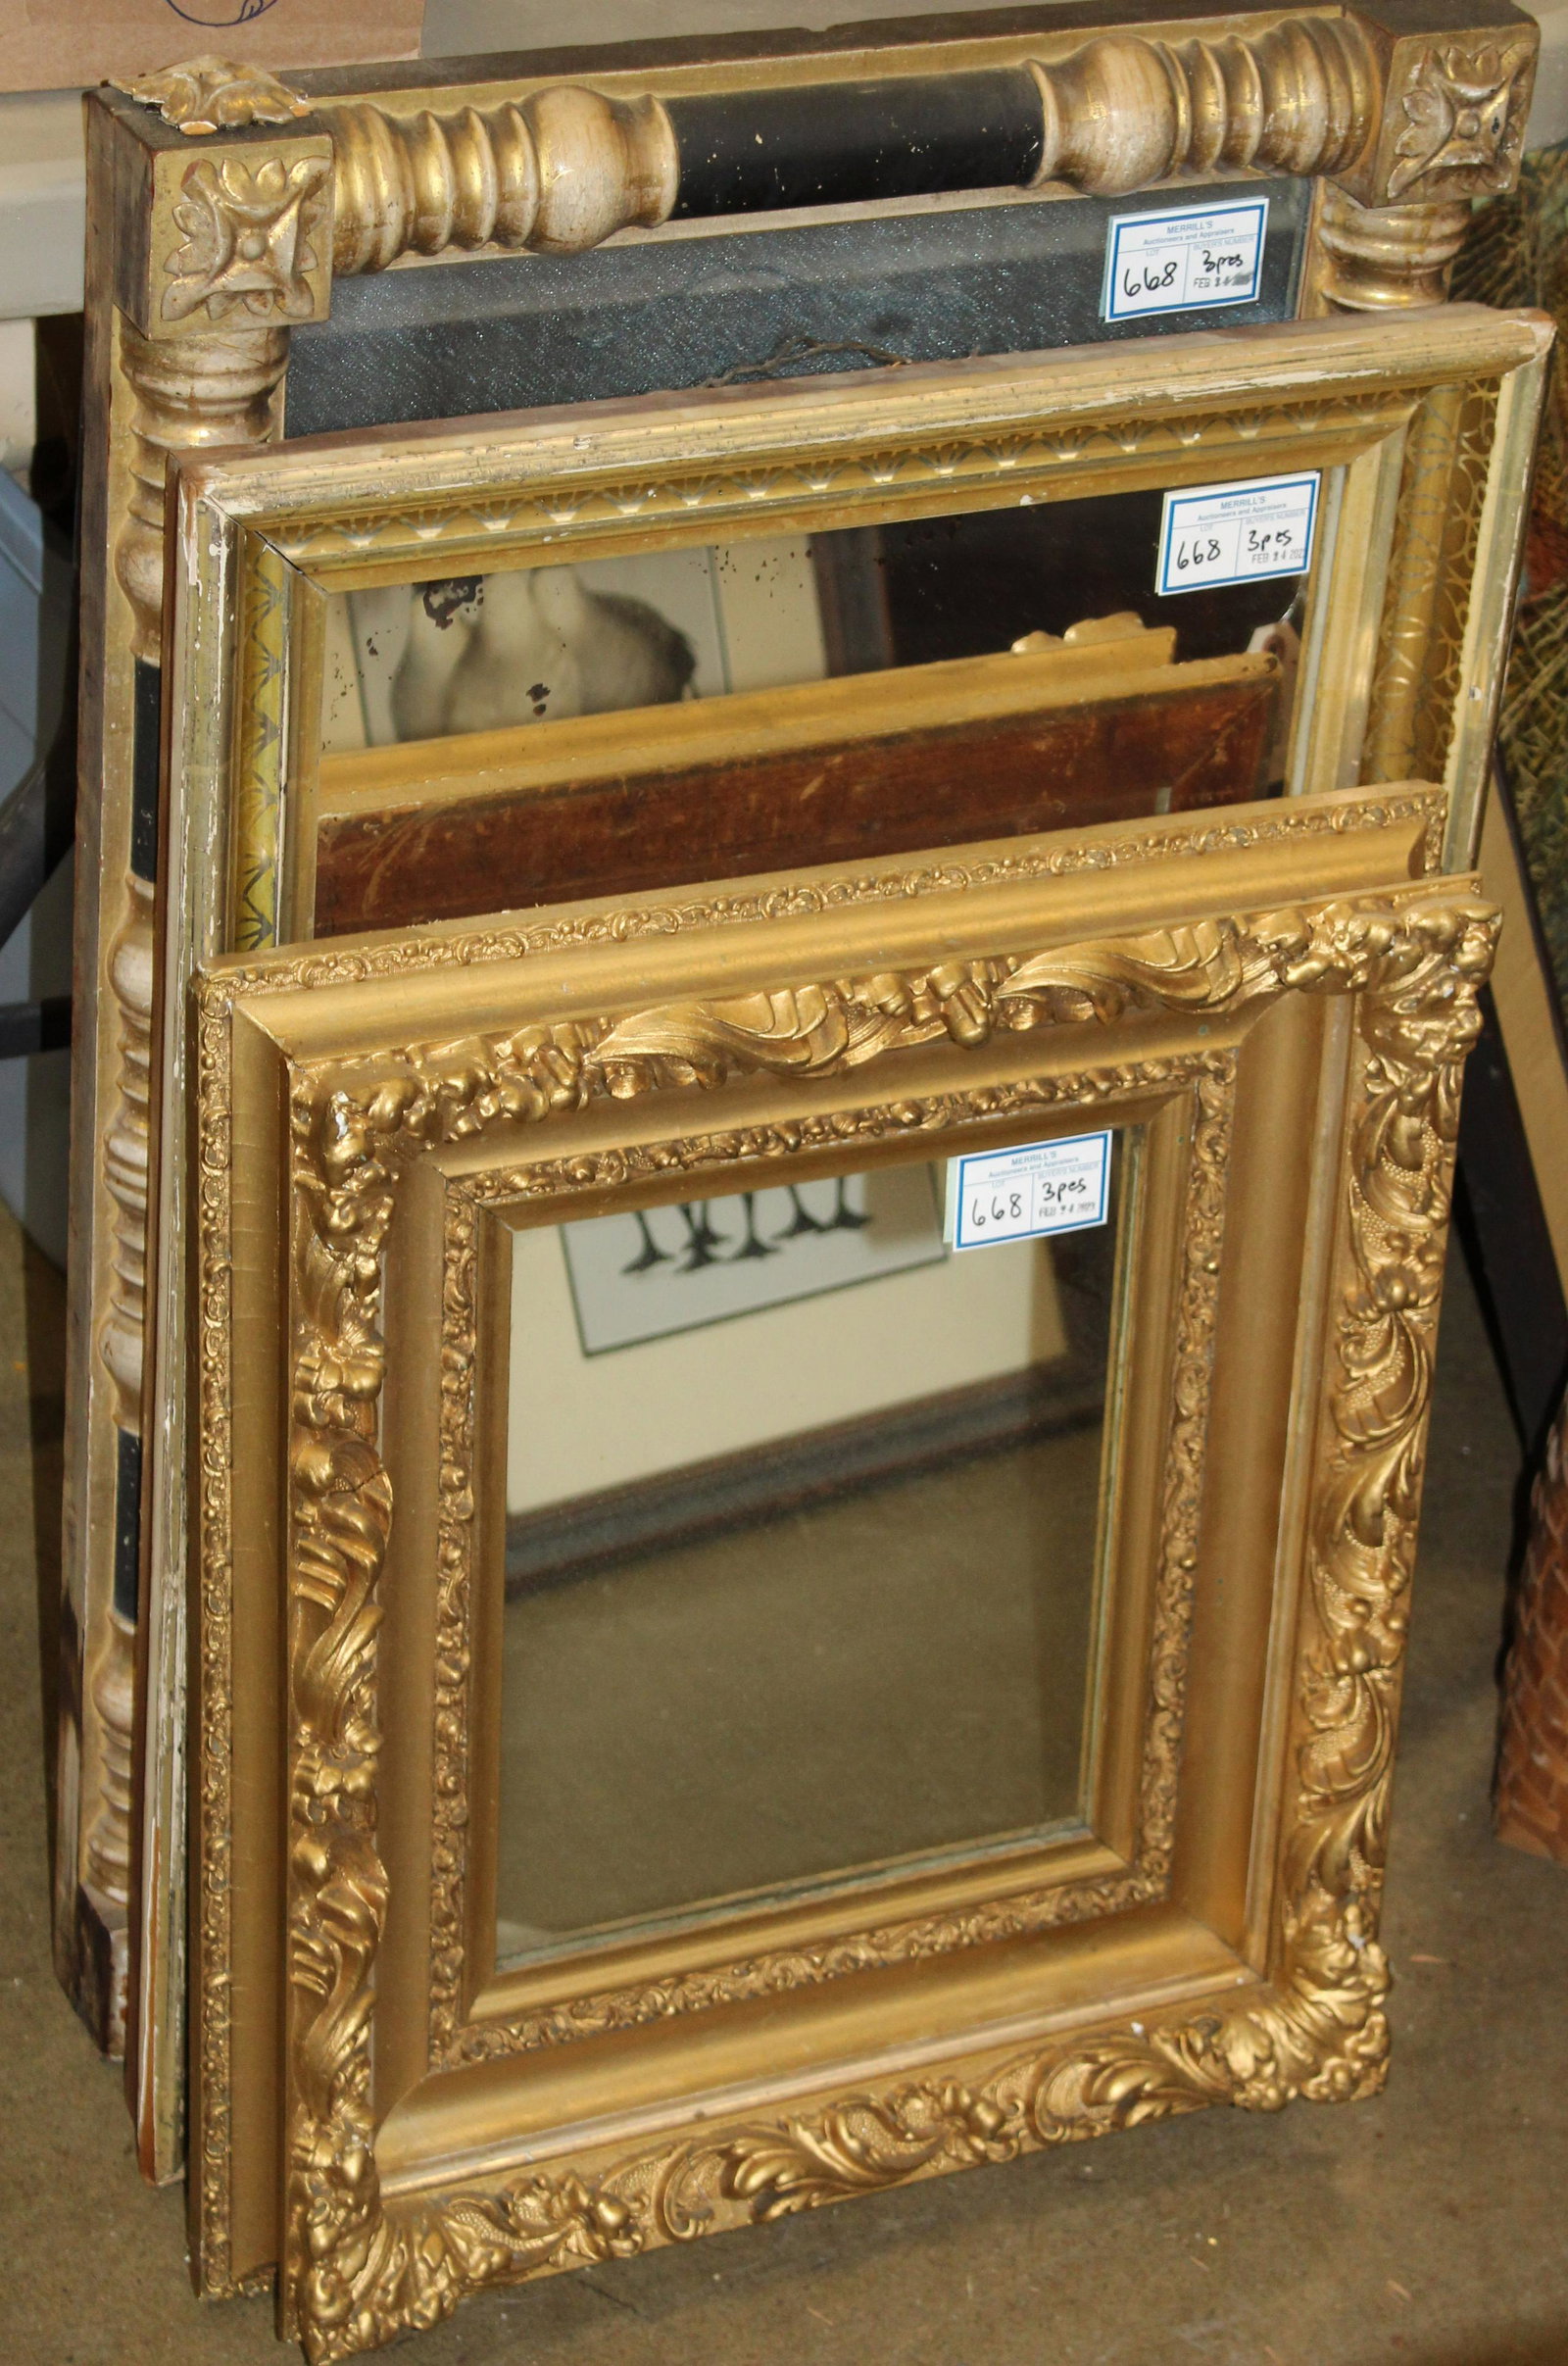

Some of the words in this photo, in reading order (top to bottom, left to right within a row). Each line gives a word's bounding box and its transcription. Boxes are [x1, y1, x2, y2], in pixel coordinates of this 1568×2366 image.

[1166, 221, 1213, 234] MERRILL'S
[1143, 235, 1183, 245] Auctioneers
[1200, 228, 1234, 239] Appraisers
[1224, 235, 1254, 245] NUMBER
[1123, 262, 1178, 297] 668
[1194, 277, 1210, 288] FEB
[1220, 496, 1265, 510] MERRILL'S
[1198, 512, 1237, 521] Auctioneers
[1251, 503, 1287, 515] Appraisers
[1276, 509, 1305, 519] NUMBER
[1177, 539, 1221, 569] 668
[1251, 553, 1269, 565] FEB
[1010, 1151, 1056, 1165] MERRILL'S
[989, 1167, 1028, 1178] Auctioneers
[1043, 1158, 1079, 1169] Appraisers
[1068, 1161, 1099, 1173] NUMBER
[971, 1193, 1022, 1226] 668
